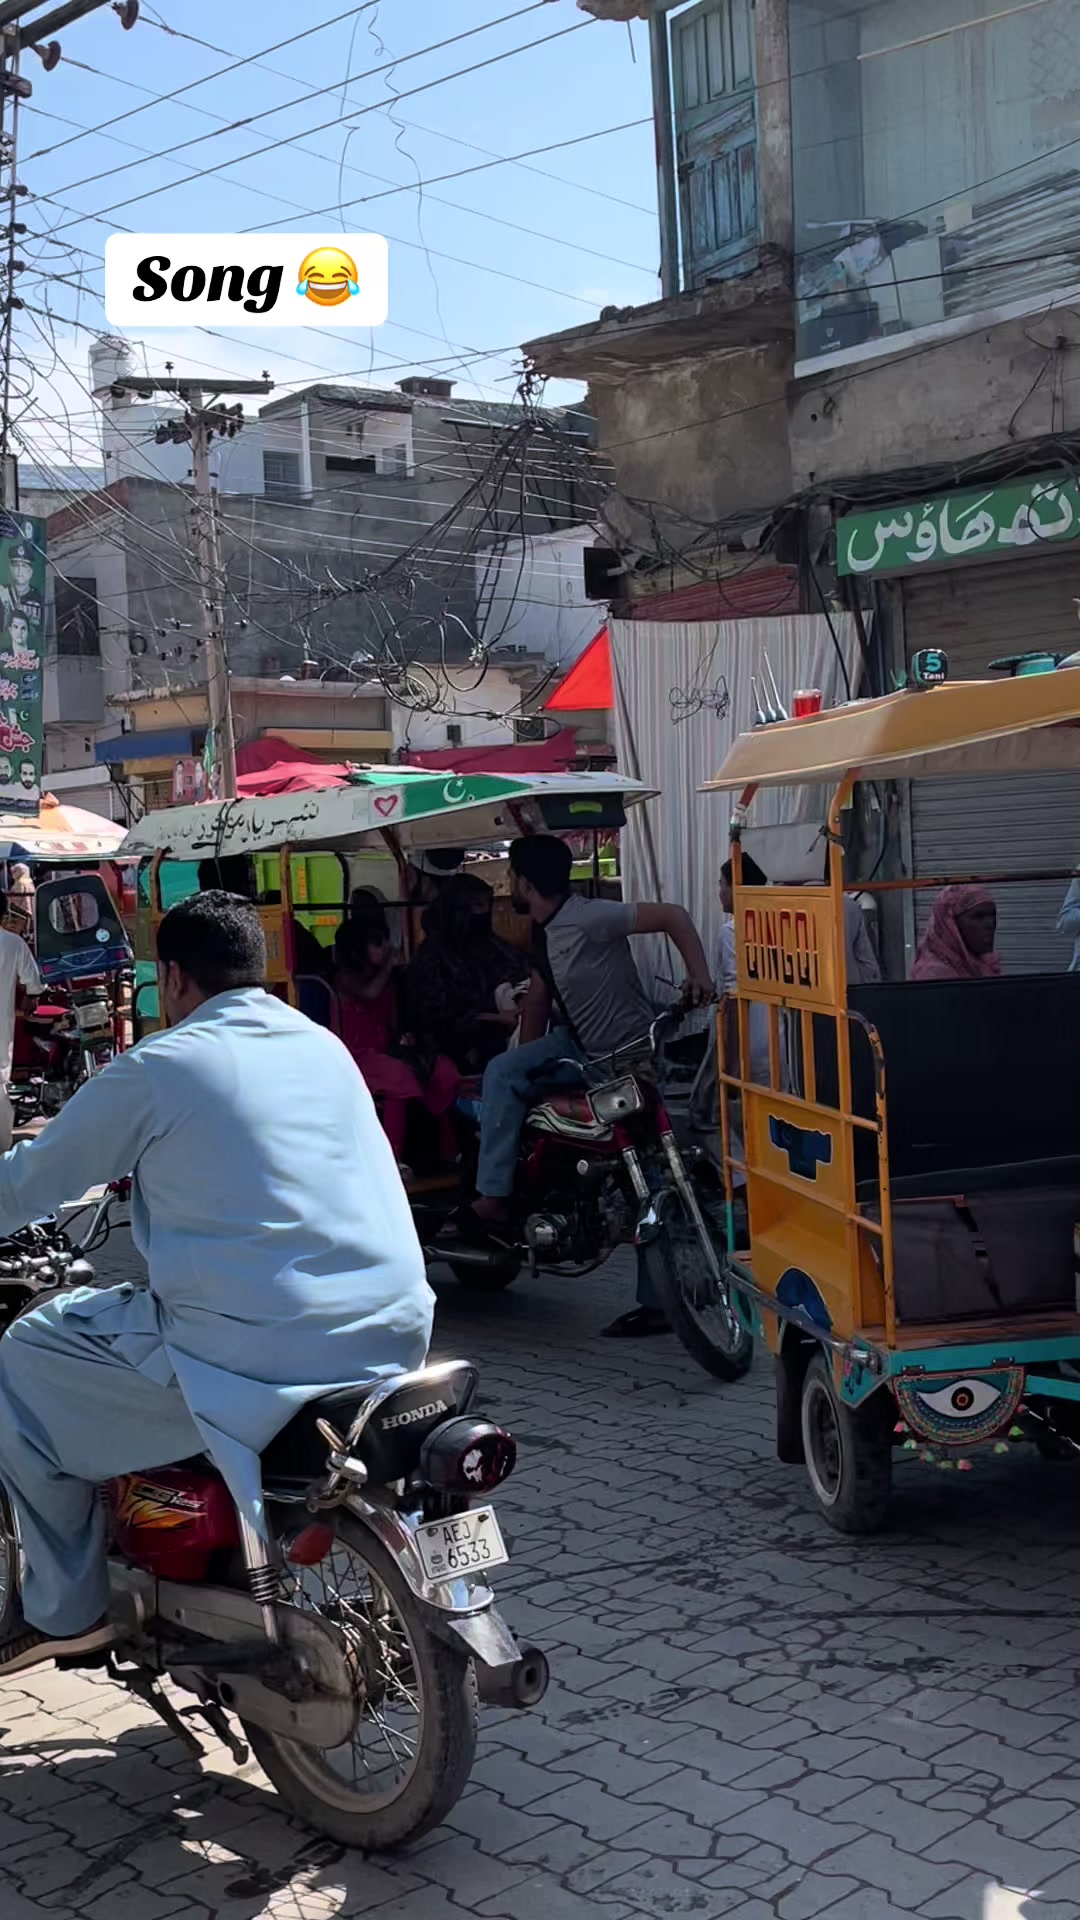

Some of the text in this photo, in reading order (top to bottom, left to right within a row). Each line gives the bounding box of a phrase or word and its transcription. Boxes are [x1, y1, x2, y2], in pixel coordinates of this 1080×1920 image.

[925, 653, 942, 672] 5
[382, 1400, 449, 1431] HONDA
[442, 1521, 471, 1546] AEJ
[447, 1539, 491, 1569] 6533
